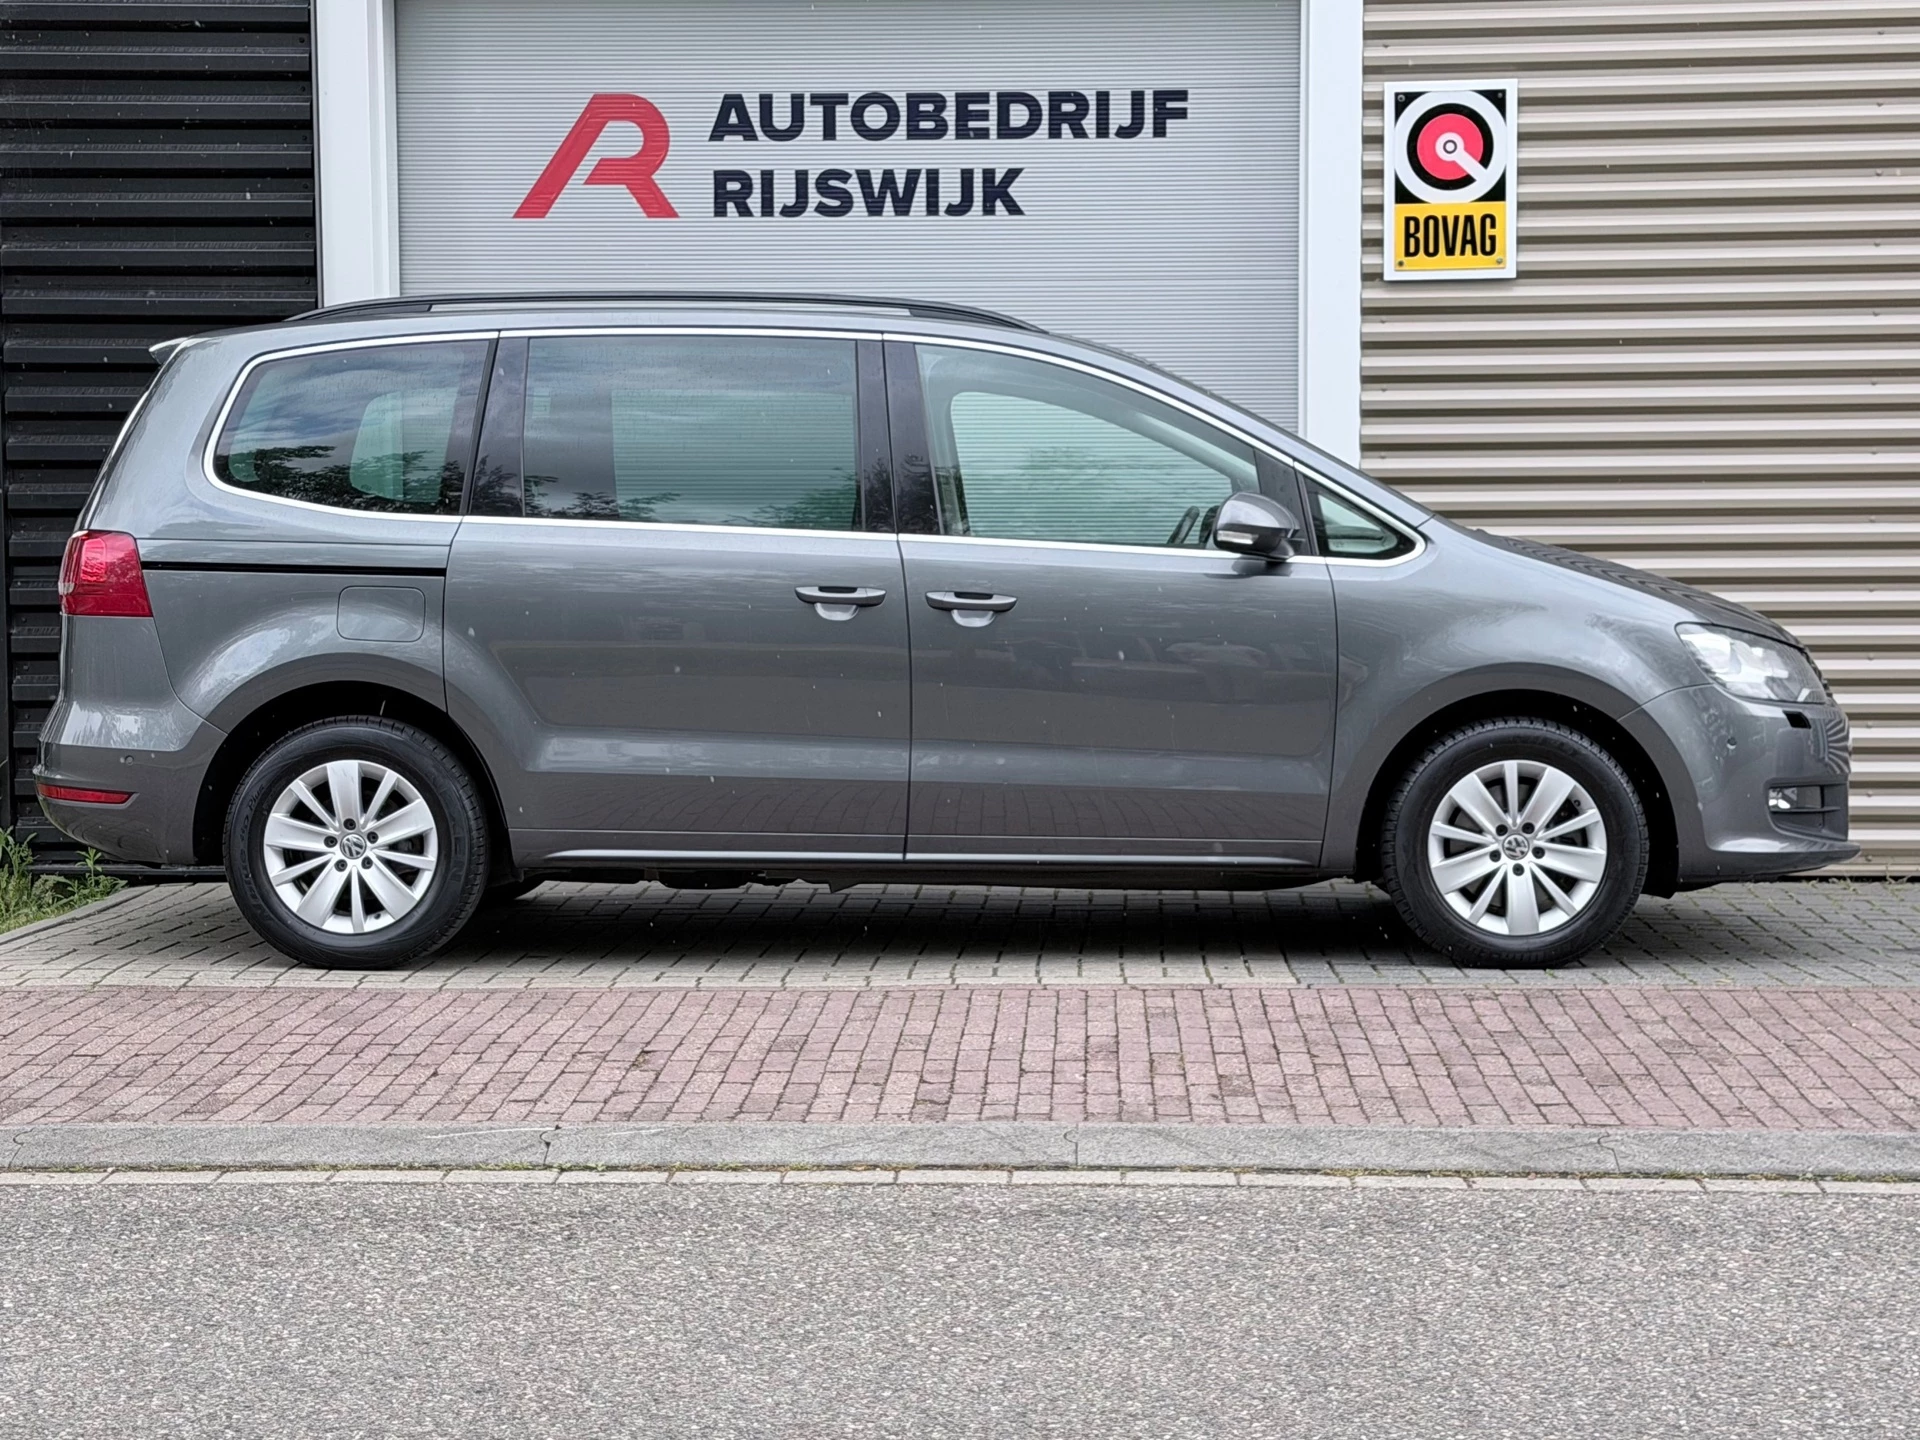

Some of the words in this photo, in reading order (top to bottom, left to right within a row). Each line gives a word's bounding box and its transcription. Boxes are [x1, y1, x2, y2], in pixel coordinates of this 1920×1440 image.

[709, 90, 1188, 141] AUTOBEDRIJF
[713, 168, 1025, 218] RIJSWIJK
[1404, 213, 1497, 258] BOVAG
